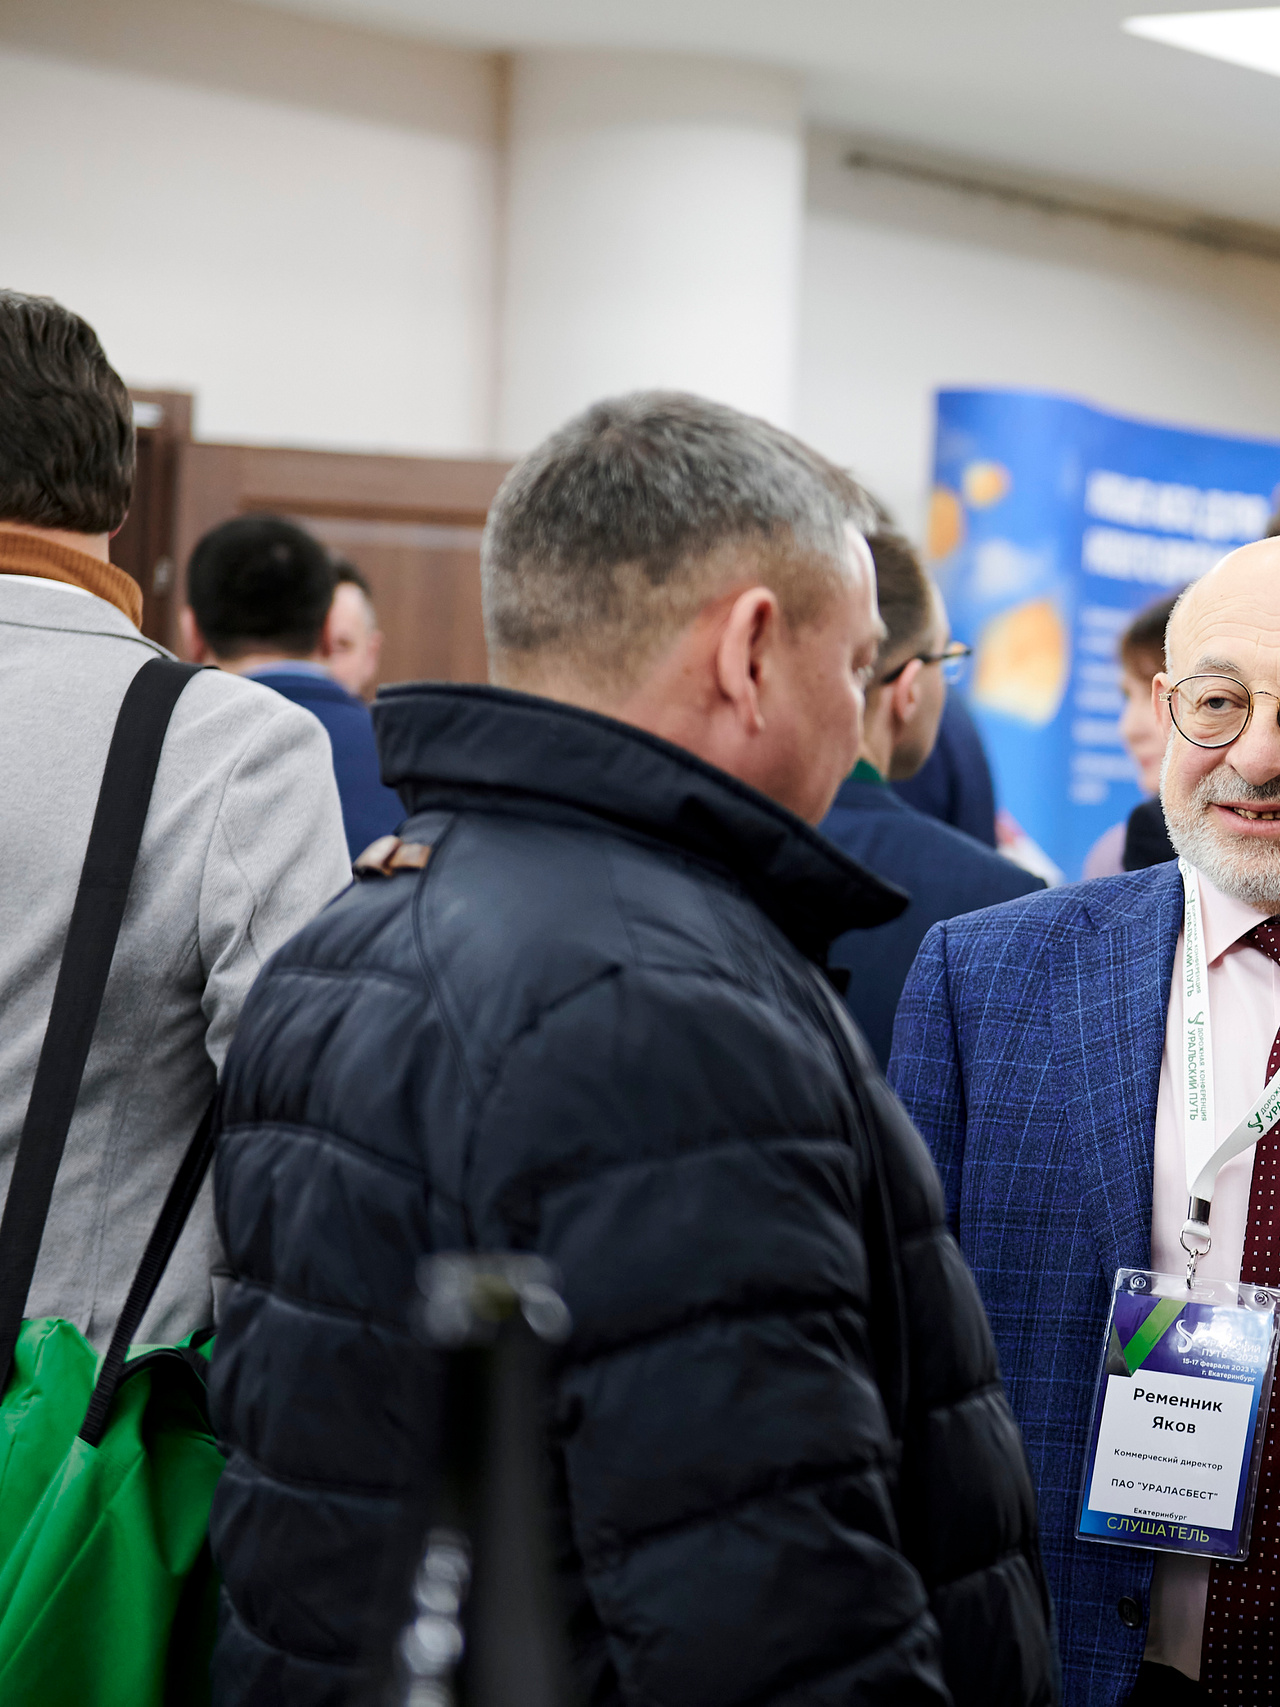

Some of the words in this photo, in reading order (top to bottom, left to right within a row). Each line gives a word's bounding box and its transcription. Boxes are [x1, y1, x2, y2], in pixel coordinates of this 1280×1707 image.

[1187, 969, 1195, 997] ПУТЬ
[1197, 1028, 1205, 1066] ДОРОЖНАЯ
[1187, 1029, 1198, 1090] УРАЛЬСКИЙ
[1189, 1092, 1198, 1121] ПУТЬ
[1201, 1348, 1227, 1359] ПУТЬ
[1236, 1353, 1259, 1363] 2023
[1203, 1337, 1261, 1354] УРСКИЙ
[1182, 1357, 1199, 1366] 15-17
[1231, 1364, 1249, 1372] 2023
[1208, 1370, 1256, 1382] Екатеринбург
[1133, 1387, 1223, 1413] Ременник
[1152, 1416, 1196, 1434] Яков
[1113, 1448, 1178, 1464] Коммерческий
[1180, 1458, 1223, 1471] директор
[1111, 1478, 1134, 1489] ПАО
[1137, 1482, 1218, 1500] "УРАЛАСБЕСТ"
[1133, 1507, 1187, 1521] Екатеринбург
[1106, 1516, 1210, 1543] СЛУШАТЕЛЬ
